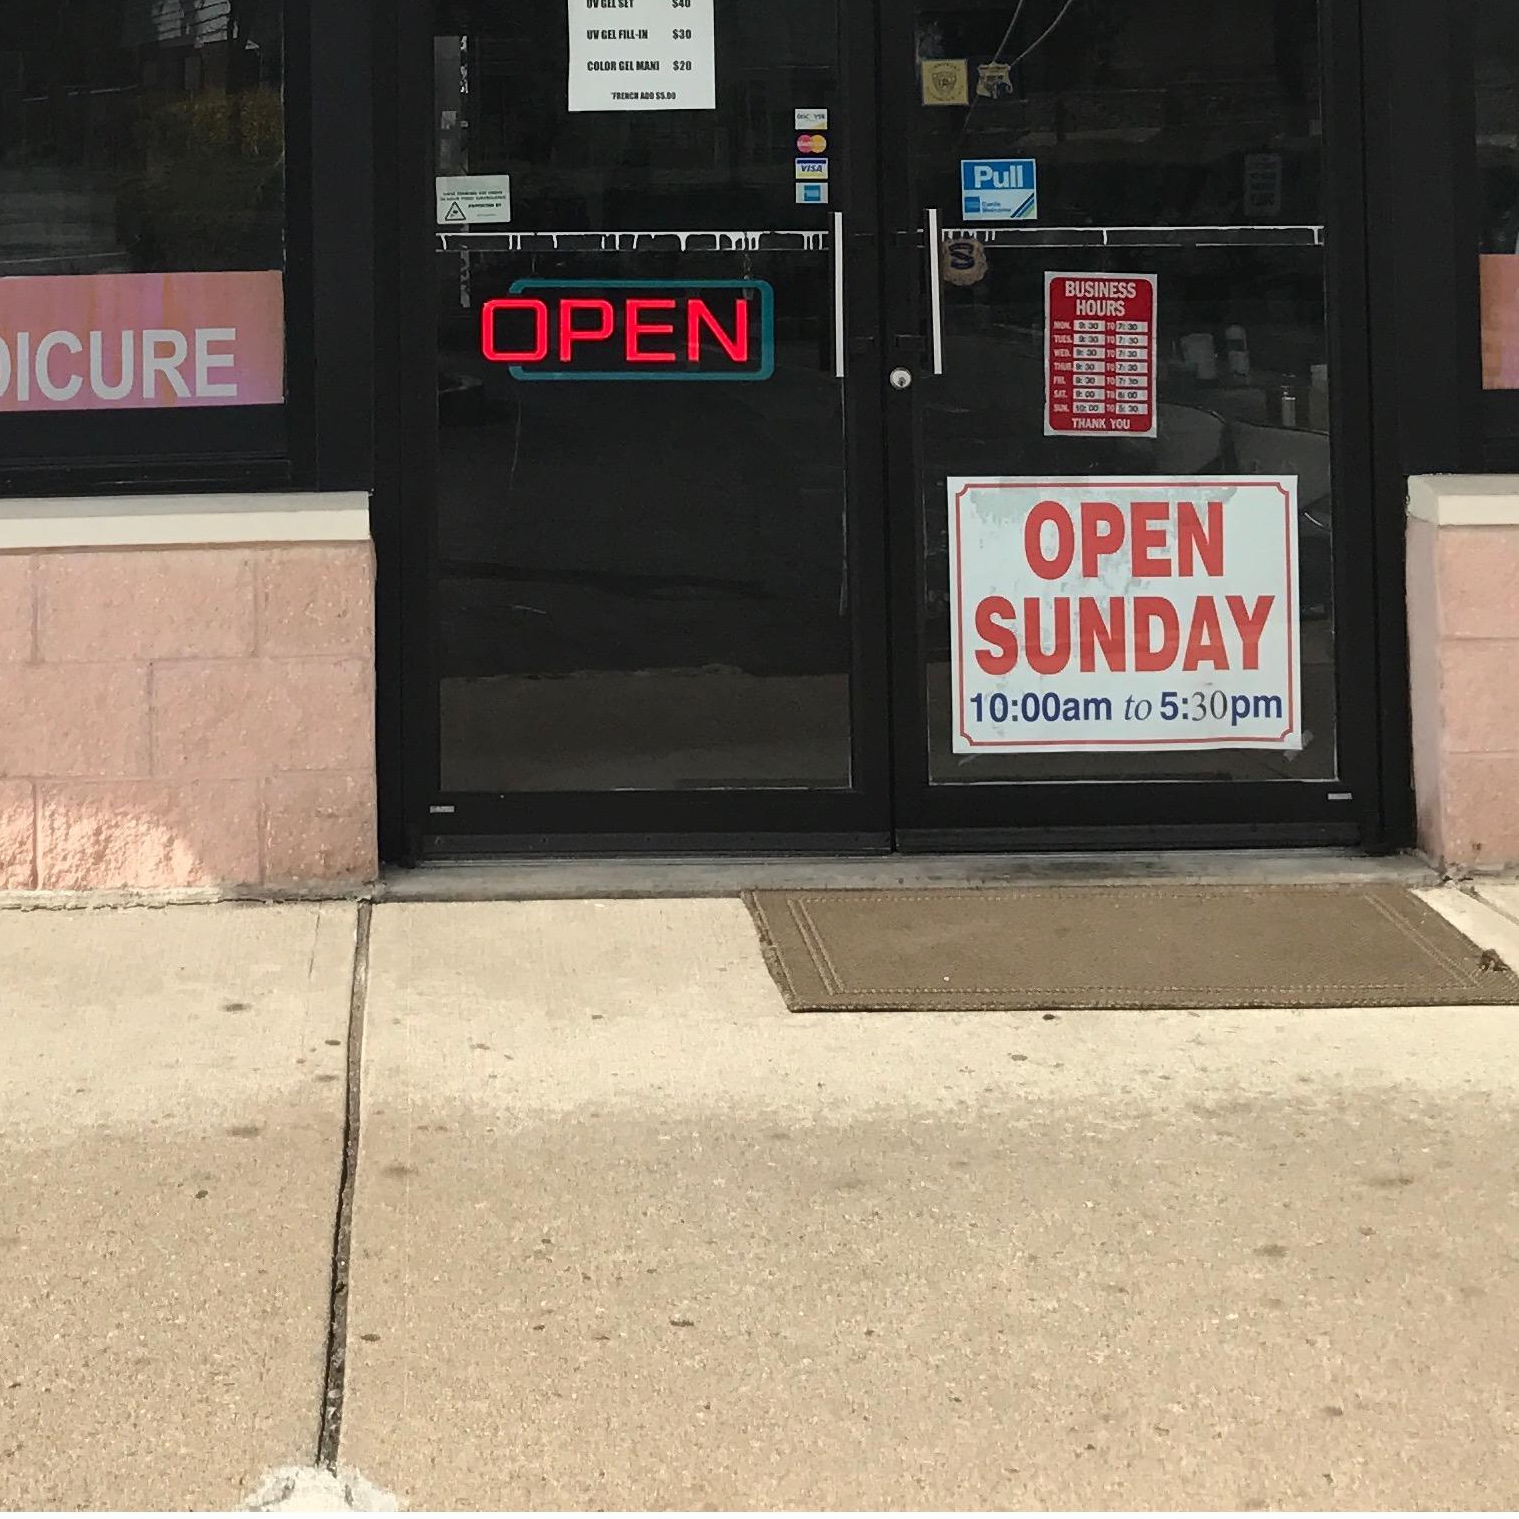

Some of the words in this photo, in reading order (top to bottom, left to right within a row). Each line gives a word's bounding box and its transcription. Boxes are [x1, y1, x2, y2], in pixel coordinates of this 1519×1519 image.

[586, 29, 599, 40] UV
[601, 29, 617, 40] GEL
[618, 29, 649, 40] FILL-IN
[672, 28, 692, 40] $30
[587, 61, 617, 71] COLOR
[618, 61, 634, 71] GEL
[635, 61, 660, 71] MANI
[672, 60, 692, 71] $20
[655, 91, 677, 100] $5.00
[801, 164, 823, 173] VISA
[974, 165, 1024, 189] Pull
[1065, 281, 1136, 298] BUSINESS
[1075, 299, 1126, 317] HOURS
[480, 297, 749, 363] OPEN
[1106, 322, 1116, 330] TO
[1106, 336, 1116, 344] TO
[1106, 349, 1116, 357] TO
[1106, 363, 1116, 371] TO
[1106, 377, 1116, 385] TO
[1106, 390, 1116, 398] TO
[1106, 404, 1116, 412] TO
[1072, 418, 1107, 429] THANK
[1110, 419, 1131, 430] YOU
[1024, 500, 1224, 580] OPEN
[974, 595, 1276, 676] SUNDAY
[970, 692, 1112, 723] 10:00am
[1124, 695, 1152, 721] to
[1160, 690, 1283, 727] 5:30pm
